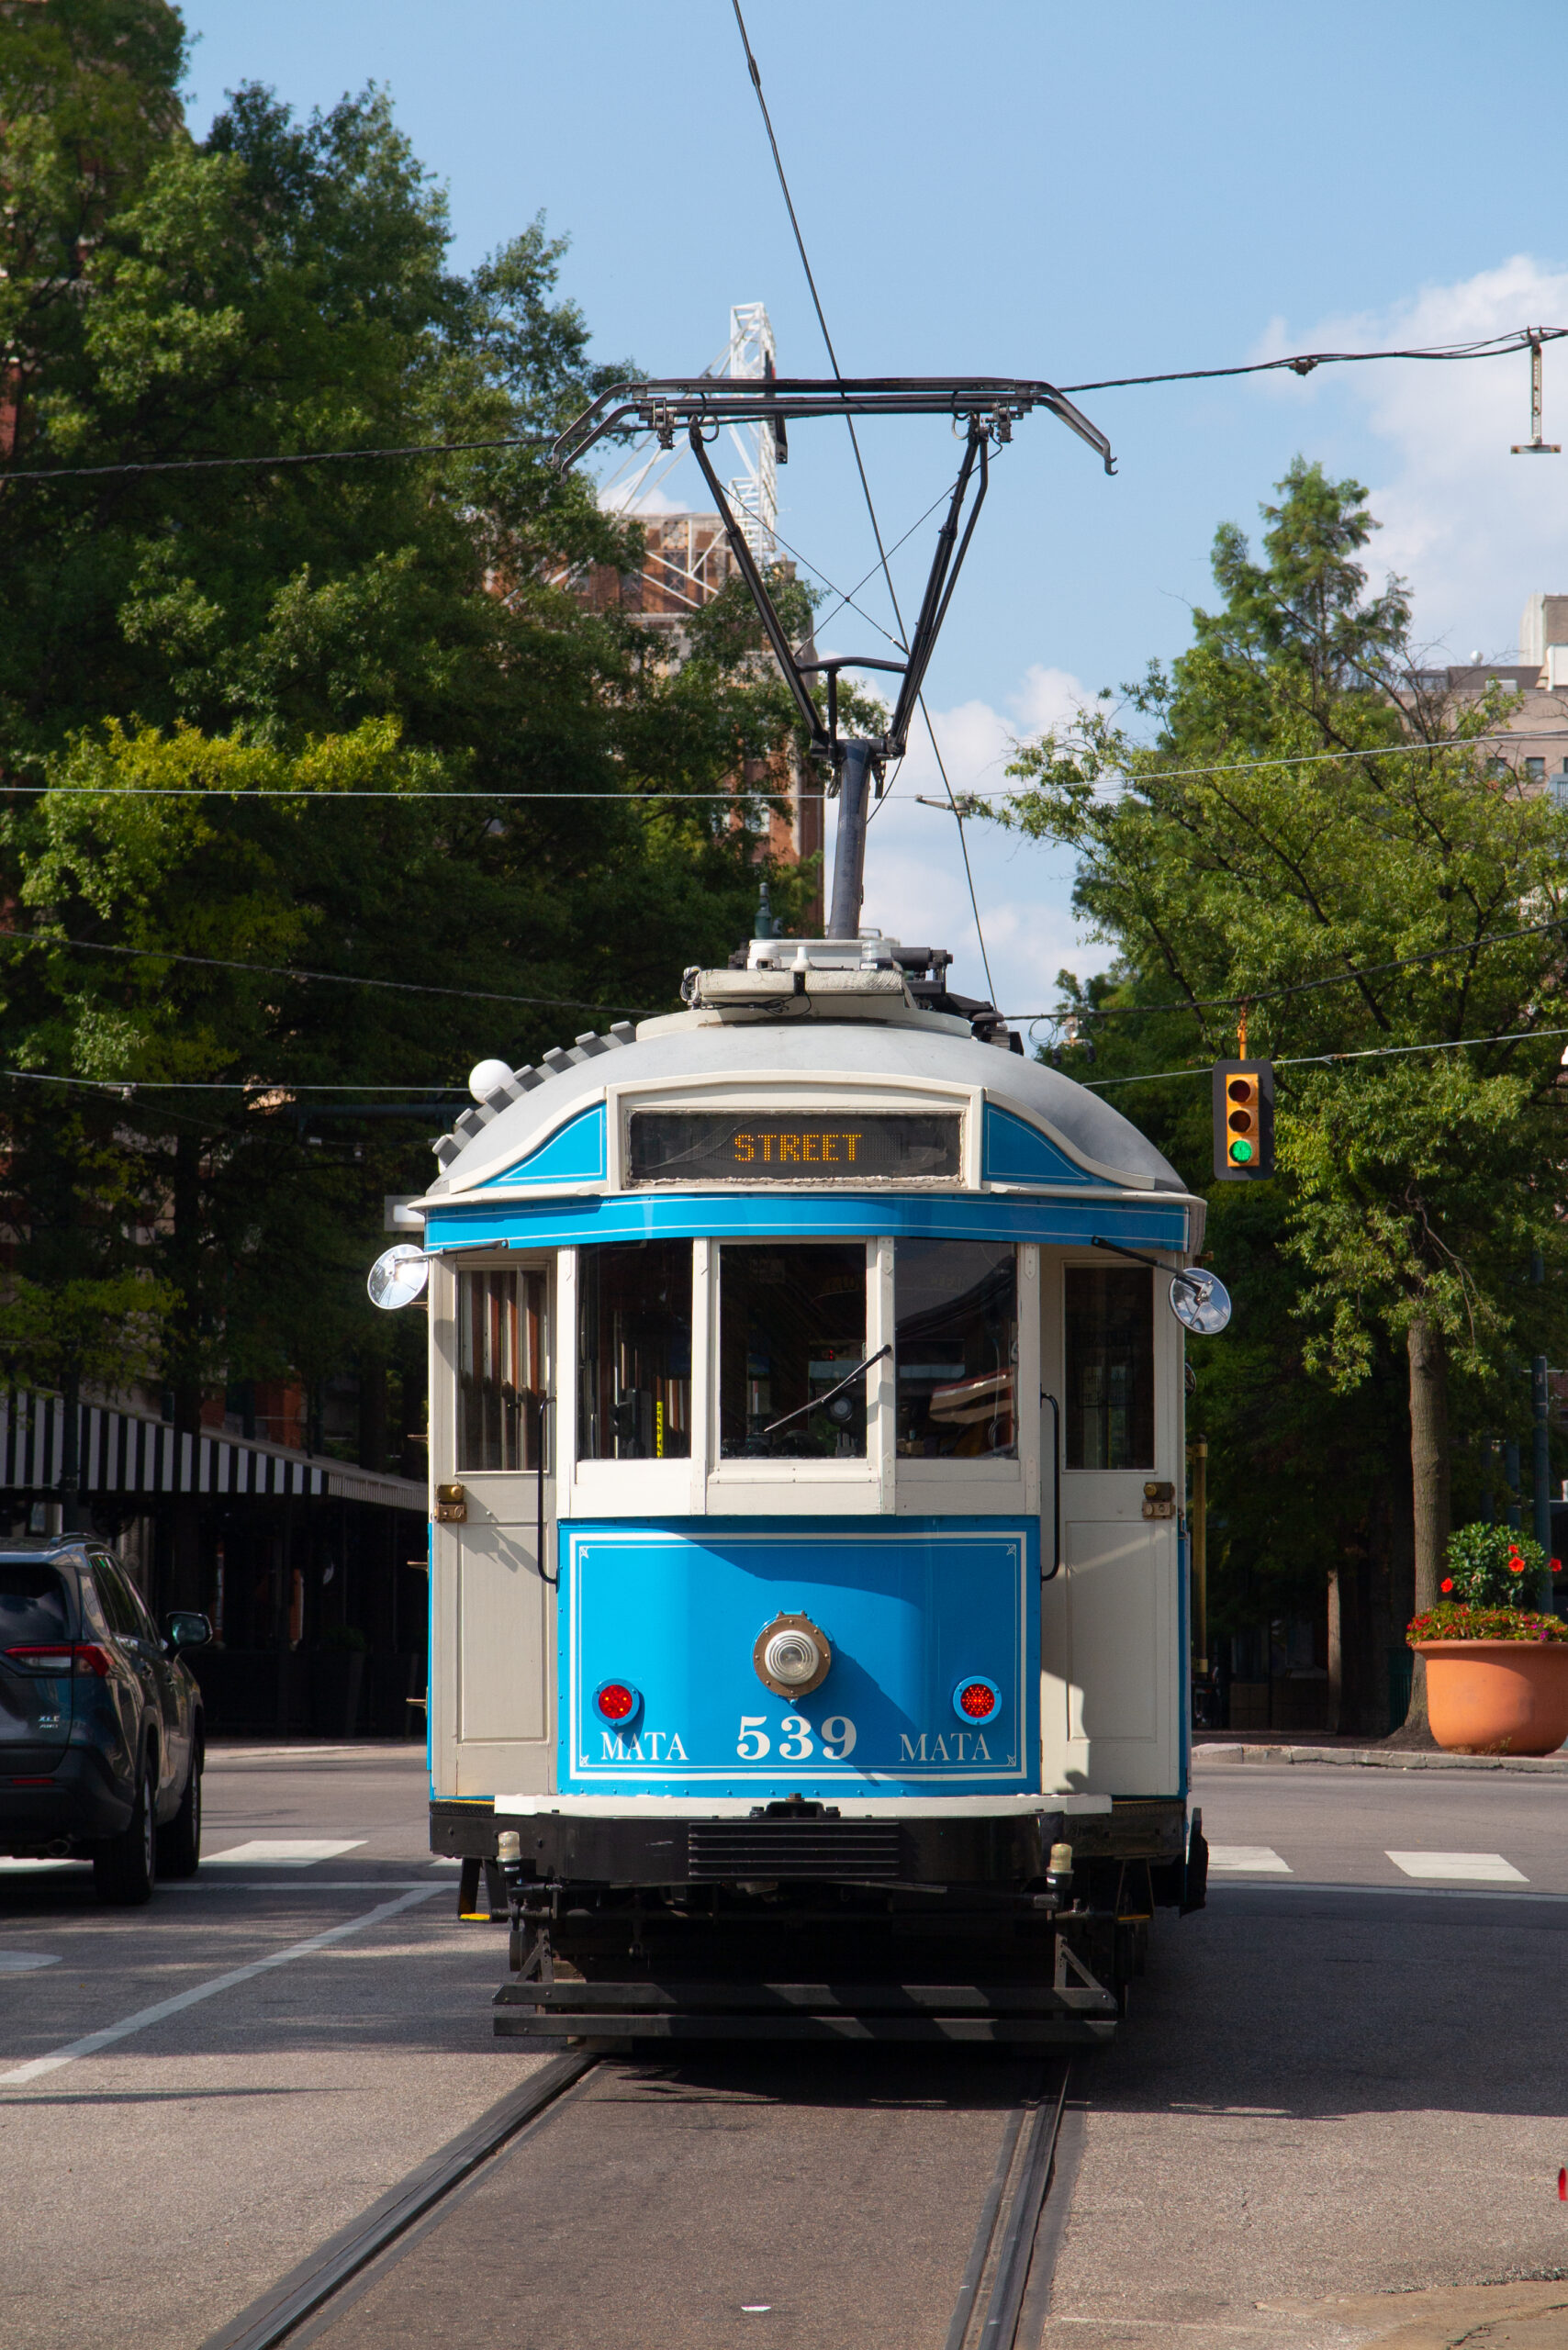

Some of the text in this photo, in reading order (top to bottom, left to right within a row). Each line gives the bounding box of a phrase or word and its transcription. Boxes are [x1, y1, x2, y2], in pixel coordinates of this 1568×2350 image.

[734, 1135, 862, 1161] STREET
[599, 1731, 690, 1761] MATA
[736, 1716, 857, 1761] 539
[899, 1733, 992, 1762] MATA
